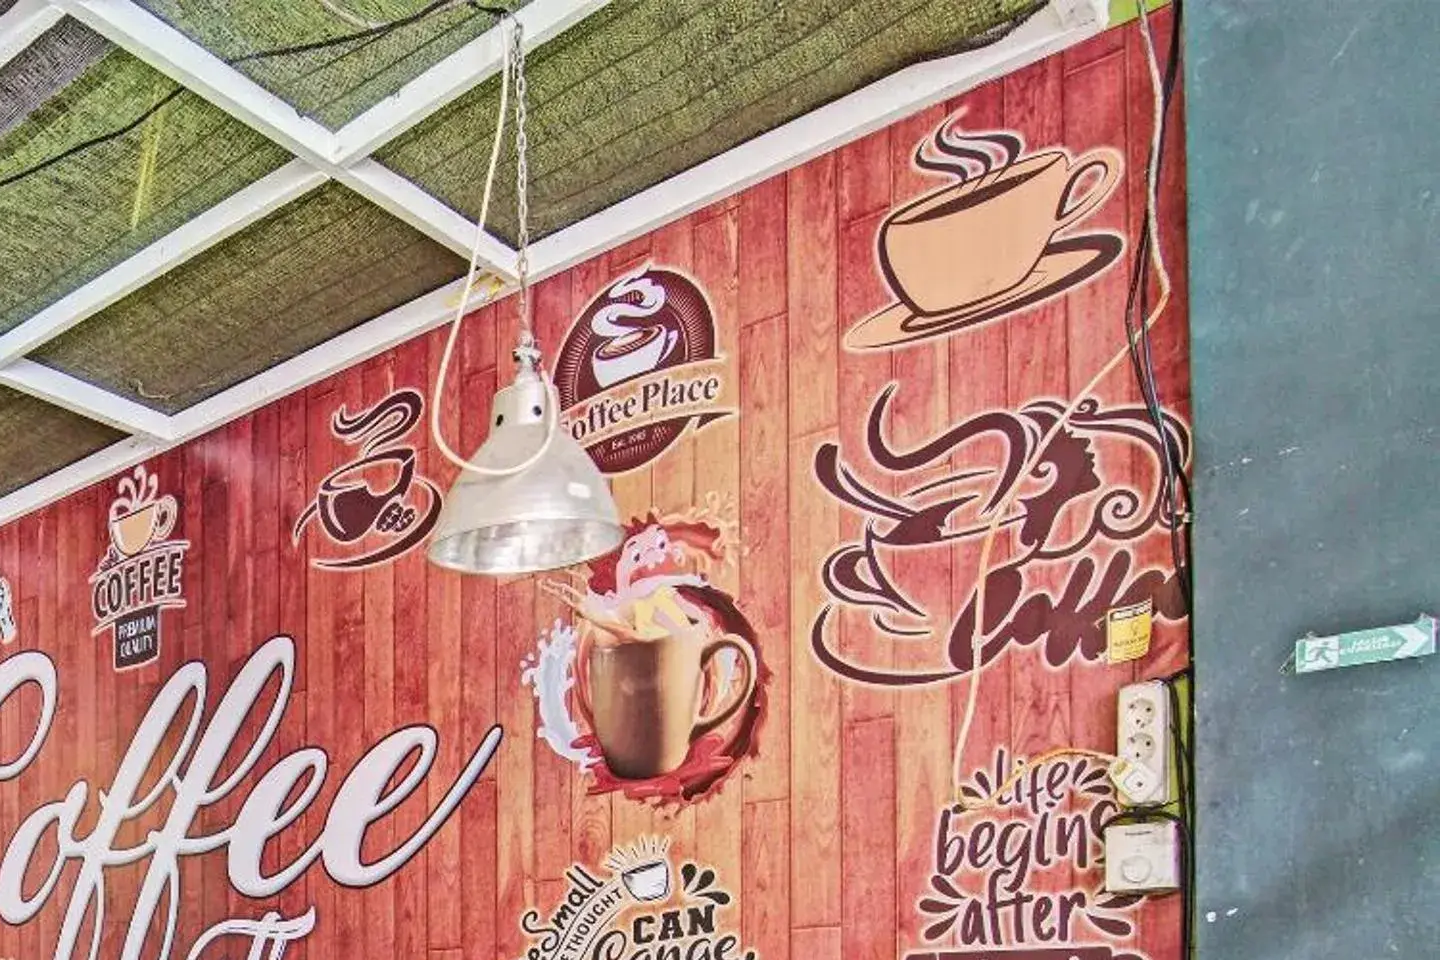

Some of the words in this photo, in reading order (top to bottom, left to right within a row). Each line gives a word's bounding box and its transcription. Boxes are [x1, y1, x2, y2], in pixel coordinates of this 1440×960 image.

[561, 396, 637, 441] offee
[642, 375, 719, 413] Place
[94, 552, 182, 619] COFFEE
[118, 614, 157, 640] PREMIUM
[120, 634, 154, 659] QUALITY
[522, 866, 603, 951] Small
[566, 889, 623, 950] THOUGHT
[633, 904, 716, 943] CAN
[961, 869, 1087, 945] after
